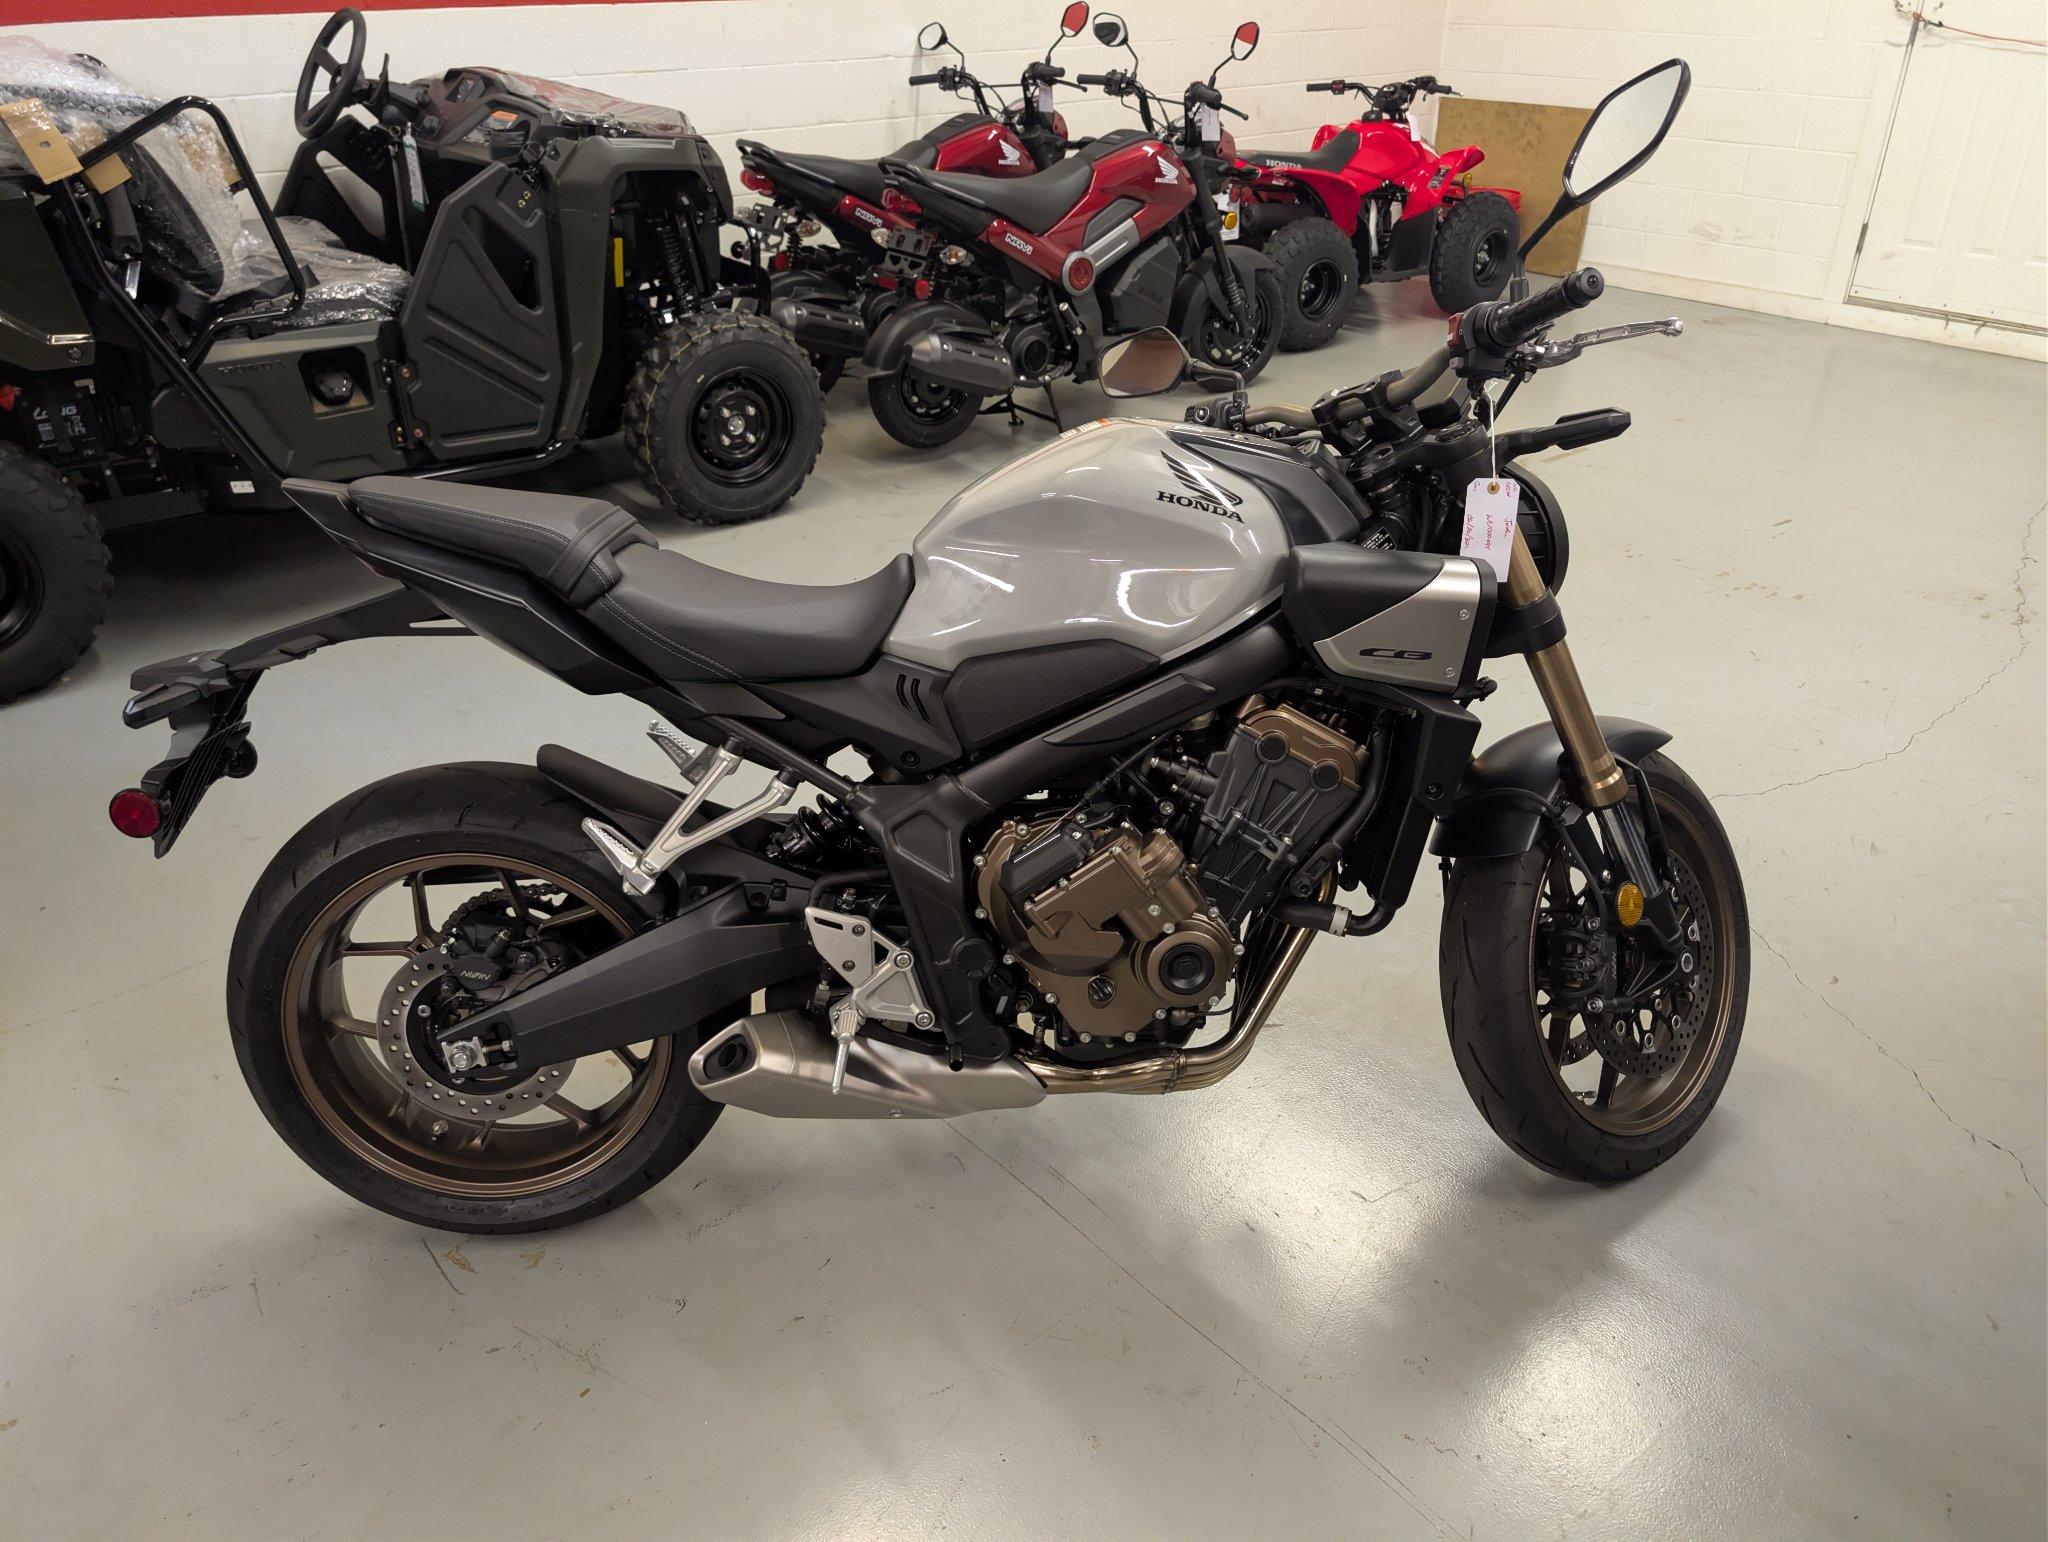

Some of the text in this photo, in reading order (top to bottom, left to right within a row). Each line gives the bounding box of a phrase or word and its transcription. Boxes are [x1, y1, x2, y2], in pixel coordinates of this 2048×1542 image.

[1265, 159, 1303, 169] HONDA
[1154, 177, 1179, 185] HONDA
[855, 207, 883, 228] NAVI
[1005, 232, 1034, 255] NAVI
[1157, 490, 1245, 524] HONDA
[1359, 647, 1434, 661] CB
